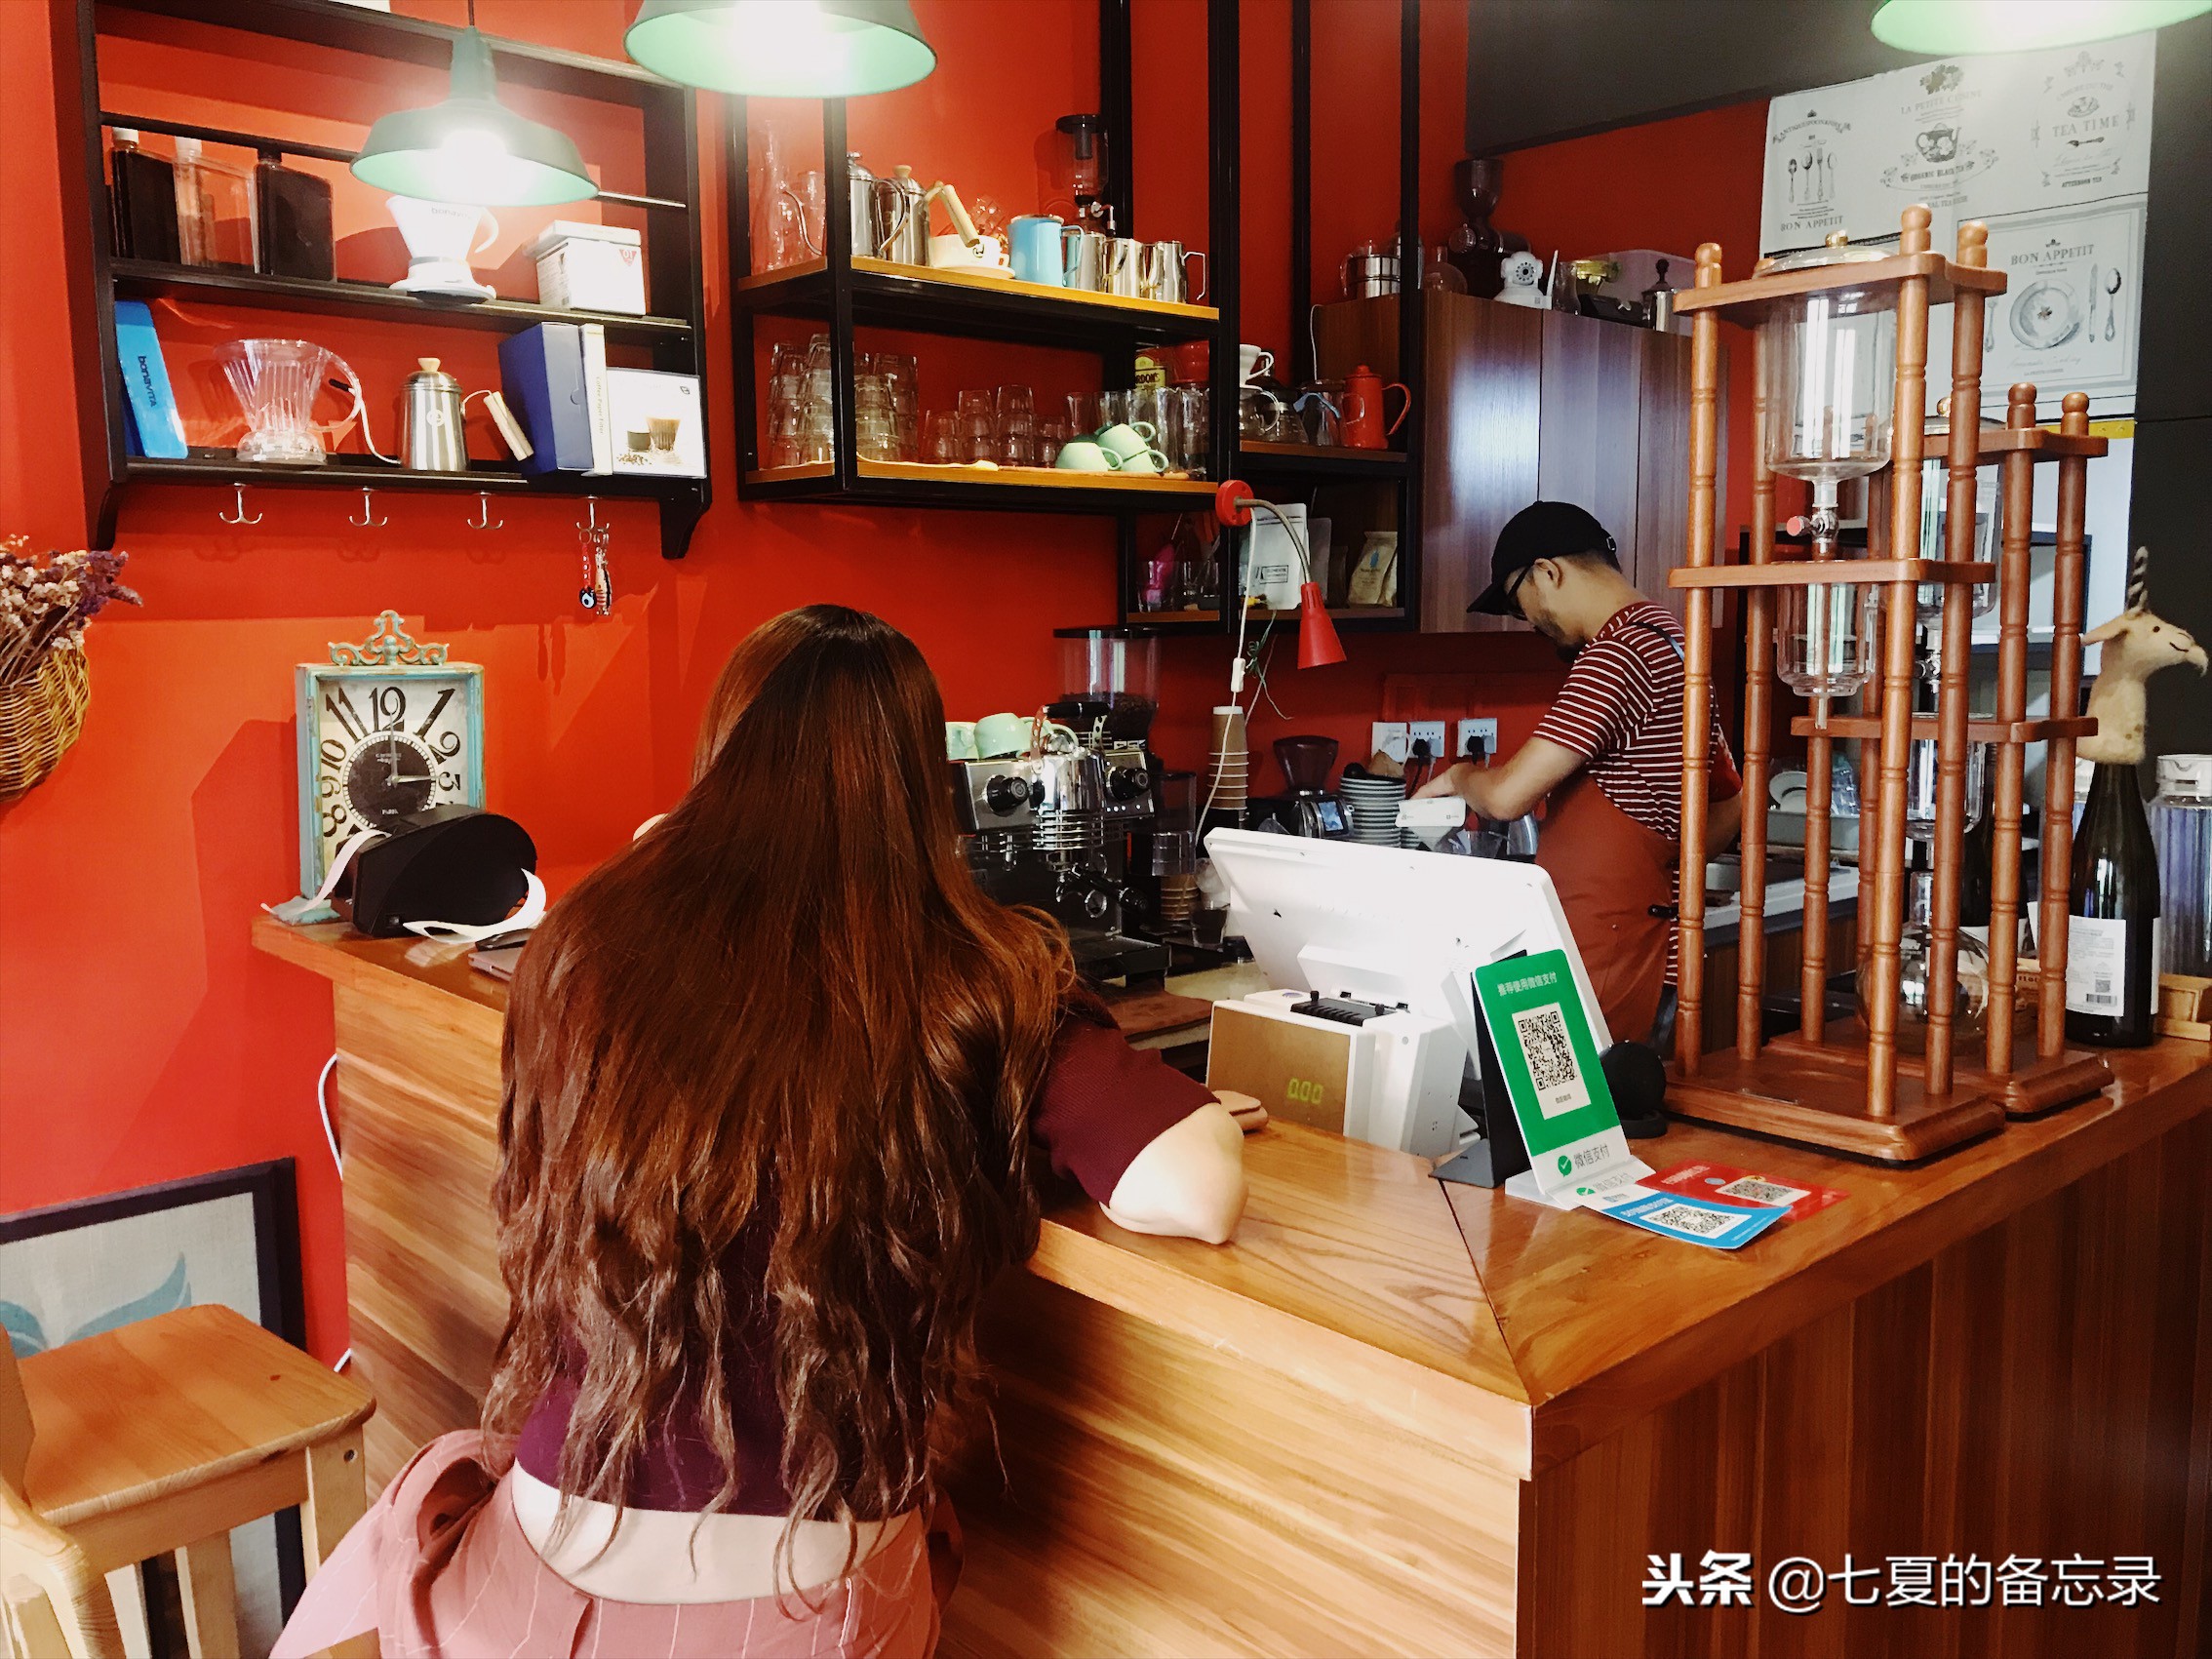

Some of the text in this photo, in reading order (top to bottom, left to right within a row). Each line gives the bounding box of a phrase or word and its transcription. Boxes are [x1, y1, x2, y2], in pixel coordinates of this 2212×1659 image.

[2052, 115, 2119, 138] TEA TIME
[431, 207, 472, 219] bonav
[1780, 216, 1844, 232] BON APPETIT
[2010, 244, 2095, 265] BON APPETIT
[1135, 373, 1161, 384] RDON'S
[325, 688, 373, 743] 11
[369, 687, 406, 732] 12
[414, 688, 455, 742] 1
[321, 738, 346, 770] 10
[428, 731, 460, 765] 2
[322, 776, 341, 799] 9
[438, 772, 460, 791] 3
[322, 805, 347, 837] 8
[1497, 971, 1558, 997] 推荐使用微信支付
[1573, 1143, 1610, 1168] 微信支付
